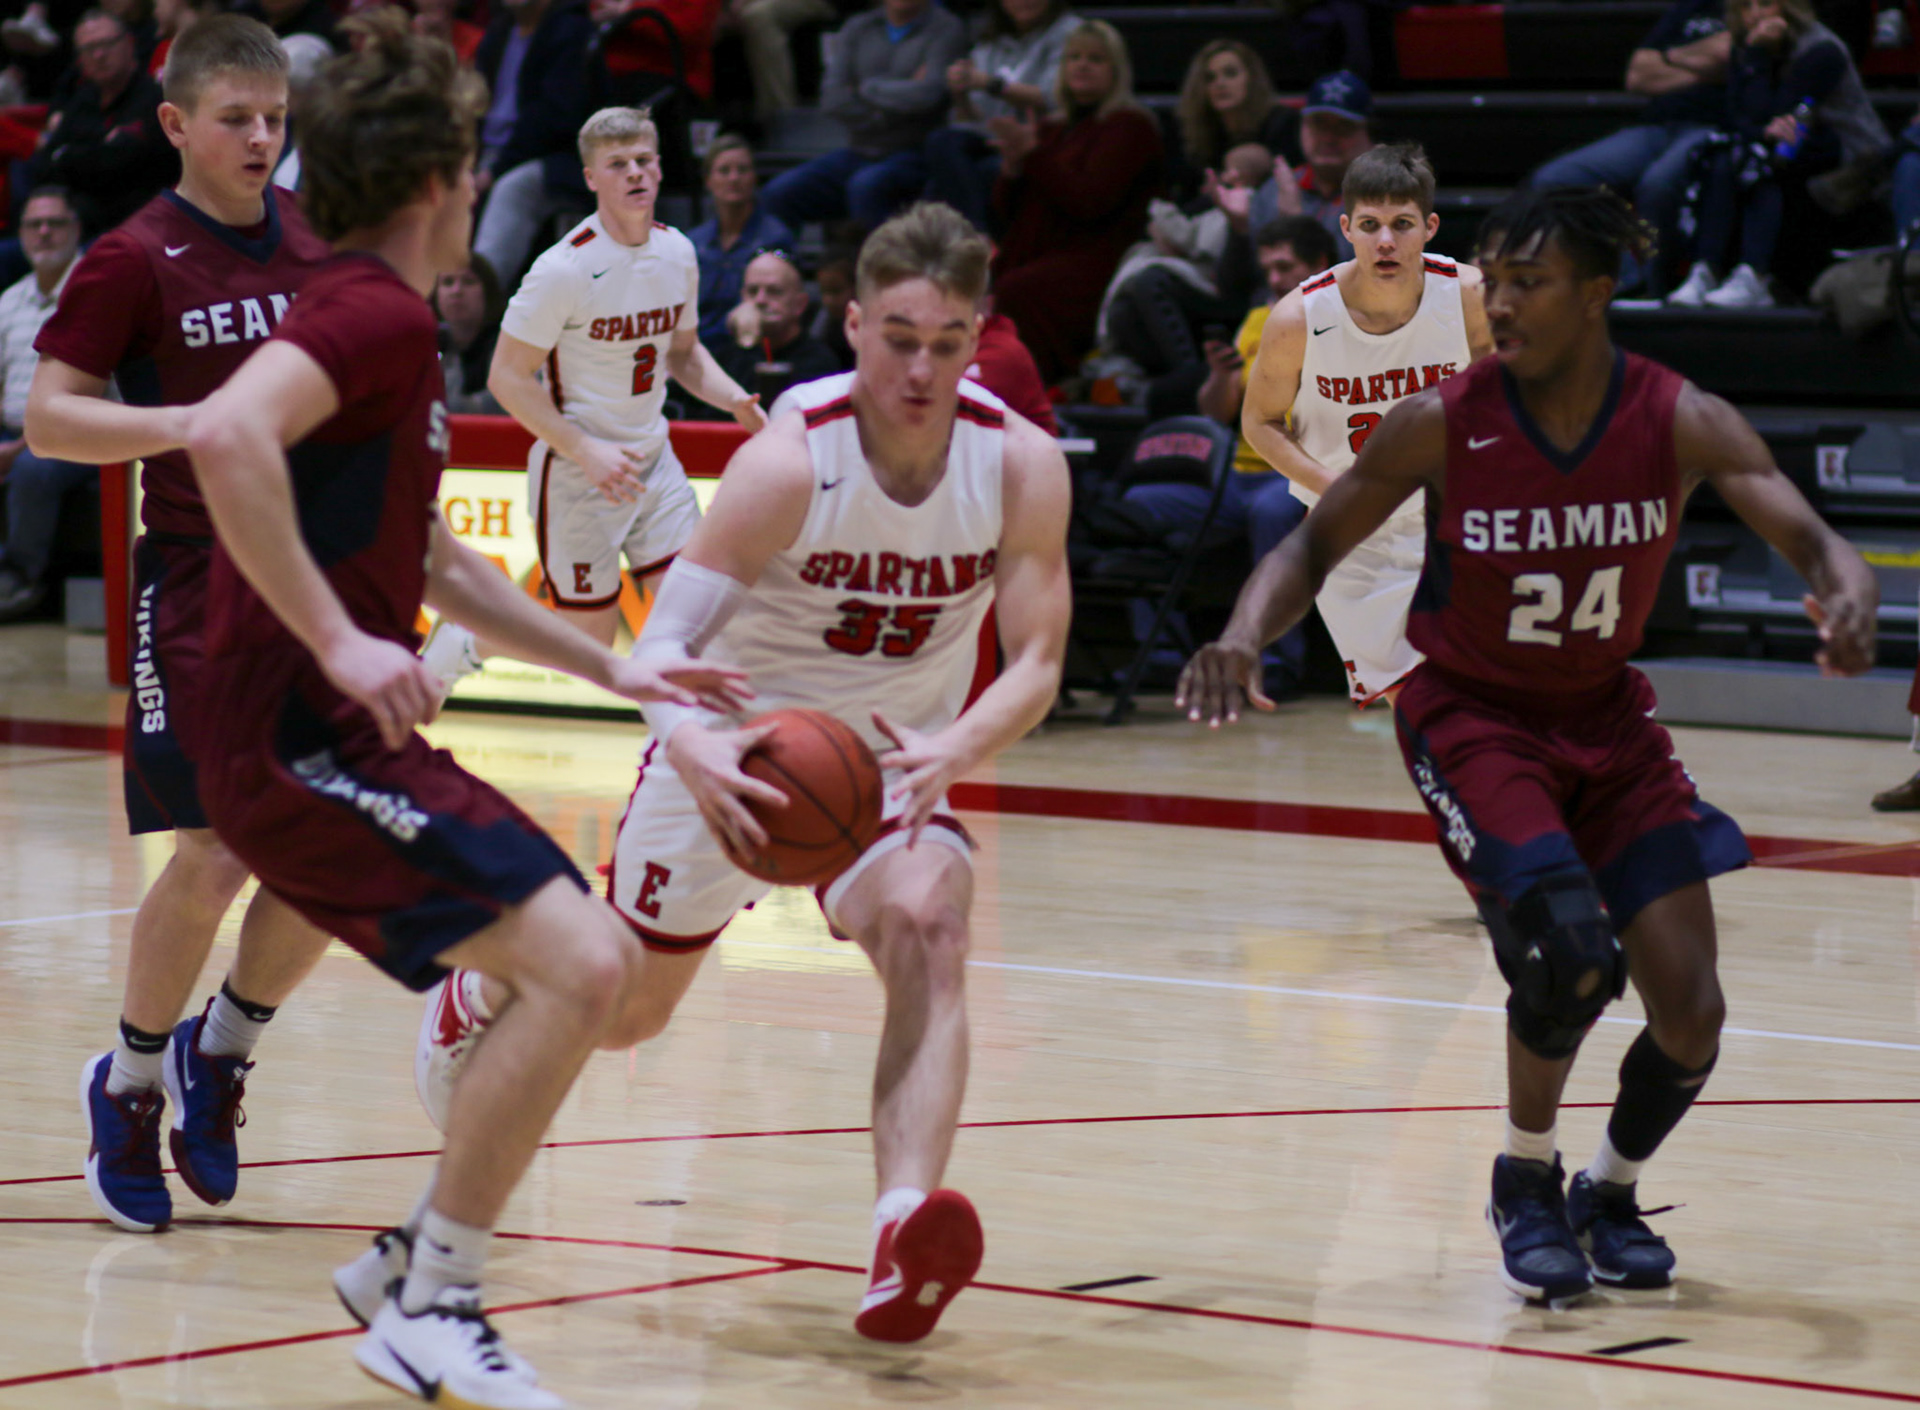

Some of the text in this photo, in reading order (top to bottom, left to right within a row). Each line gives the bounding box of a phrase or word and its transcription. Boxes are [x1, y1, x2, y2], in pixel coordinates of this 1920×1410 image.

[631, 343, 657, 396] 2
[1316, 362, 1457, 405] SPARTANS
[1463, 498, 1667, 551] SEAMAN
[573, 563, 593, 594] E
[800, 548, 998, 597] SPARTANS
[823, 598, 945, 658] 35
[1507, 566, 1624, 647] 24
[134, 583, 166, 733] VIKINGS
[634, 860, 672, 920] E
